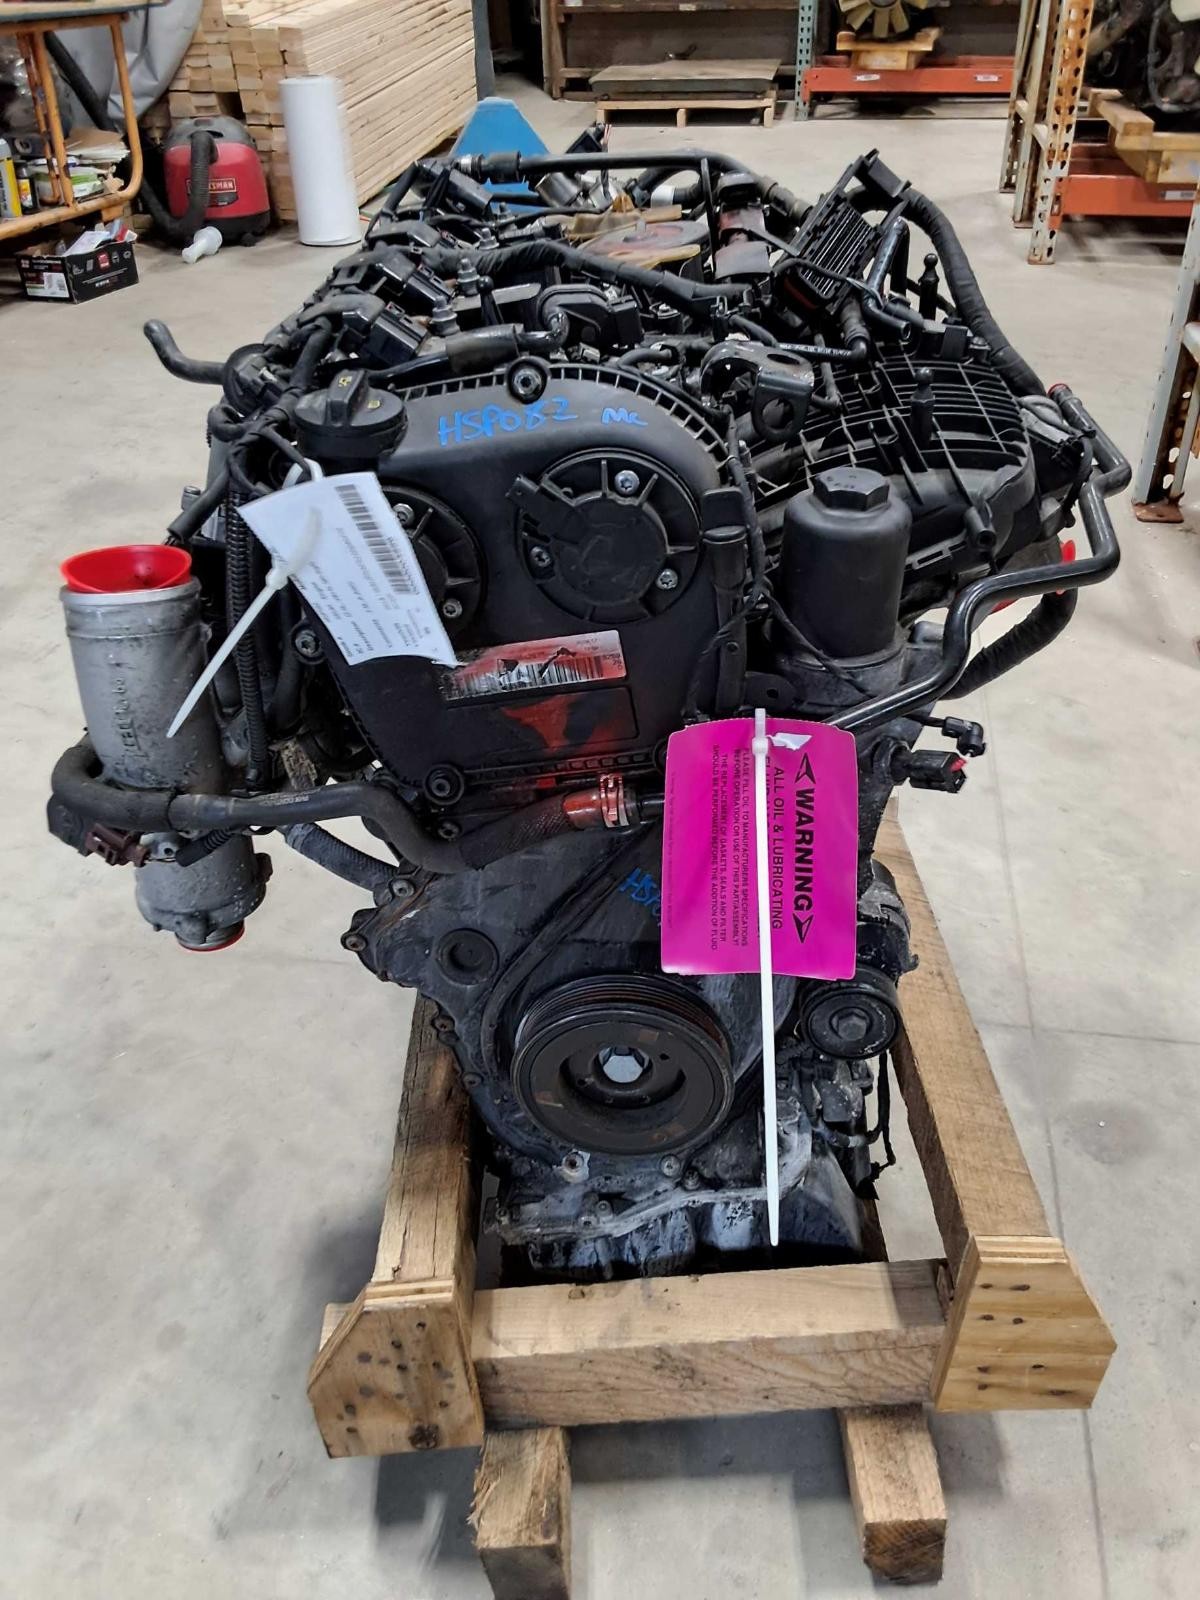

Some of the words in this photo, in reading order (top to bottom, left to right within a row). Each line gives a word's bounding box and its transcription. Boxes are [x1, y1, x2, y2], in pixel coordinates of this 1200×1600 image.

[773, 766, 785, 794] ALL
[742, 810, 749, 820] TO
[773, 797, 785, 820] OIL
[773, 824, 784, 833] &
[733, 855, 739, 865] OF
[794, 788, 815, 912] WARNING
[772, 838, 784, 929] LUBRICATING
